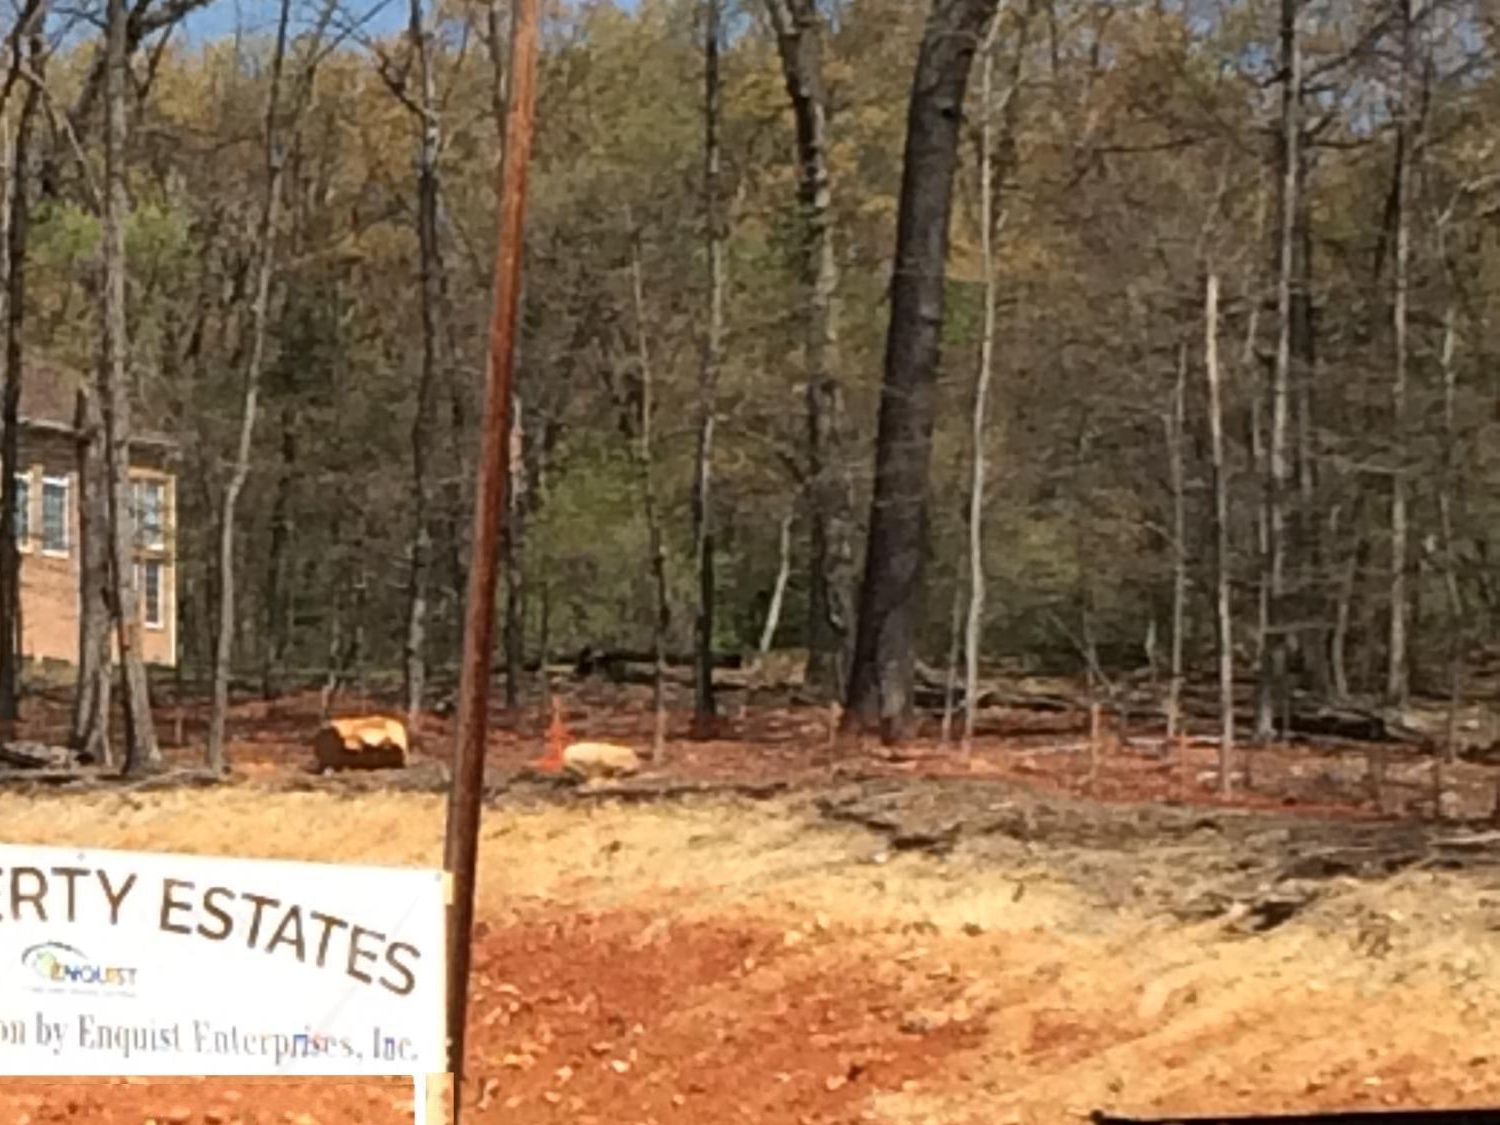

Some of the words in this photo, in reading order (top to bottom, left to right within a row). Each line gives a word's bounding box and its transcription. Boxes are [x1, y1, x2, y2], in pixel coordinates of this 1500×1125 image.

[159, 878, 421, 997] ESTATES
[36, 1012, 68, 1056] by
[79, 1014, 181, 1059] Enquist
[193, 1020, 364, 1066] Enterprises,
[373, 1026, 418, 1062] Inc.
